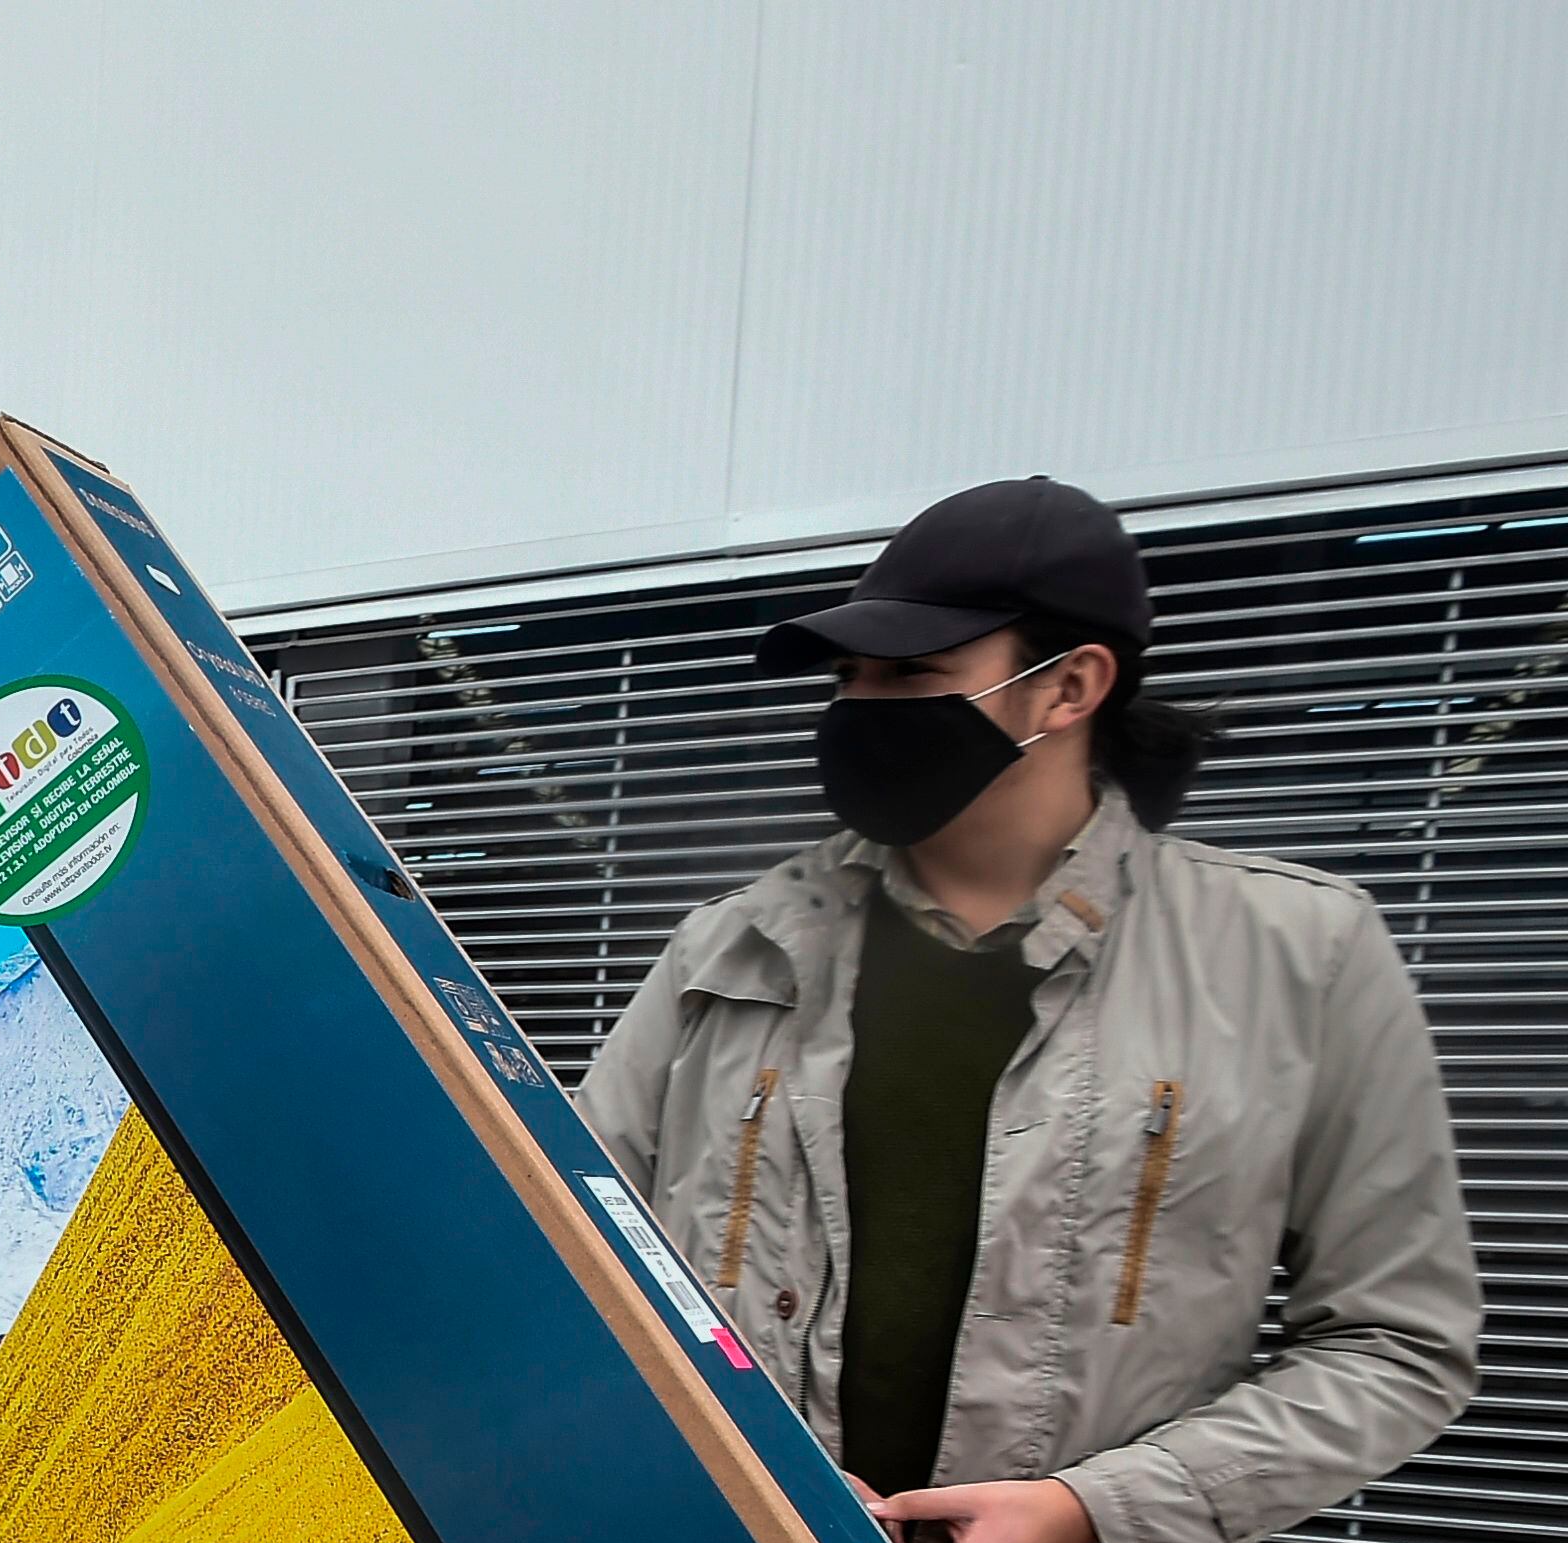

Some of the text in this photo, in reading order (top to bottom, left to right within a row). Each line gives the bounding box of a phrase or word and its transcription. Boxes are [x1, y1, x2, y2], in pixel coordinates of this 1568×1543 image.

[36, 755, 59, 776] Digital
[58, 743, 74, 759] para
[73, 725, 94, 745] Todos
[42, 775, 76, 807] RECIBE
[75, 762, 91, 778] LA
[89, 734, 123, 766] SEÑAL
[65, 731, 99, 762] Colombia
[31, 812, 78, 854] ADOPTADO
[76, 800, 92, 815] EN
[89, 759, 141, 805] COLOMBIA.
[38, 795, 75, 829] DIGITAL
[78, 747, 132, 795] TERRESTRE
[20, 877, 52, 906] Consulte
[66, 831, 109, 868] información
